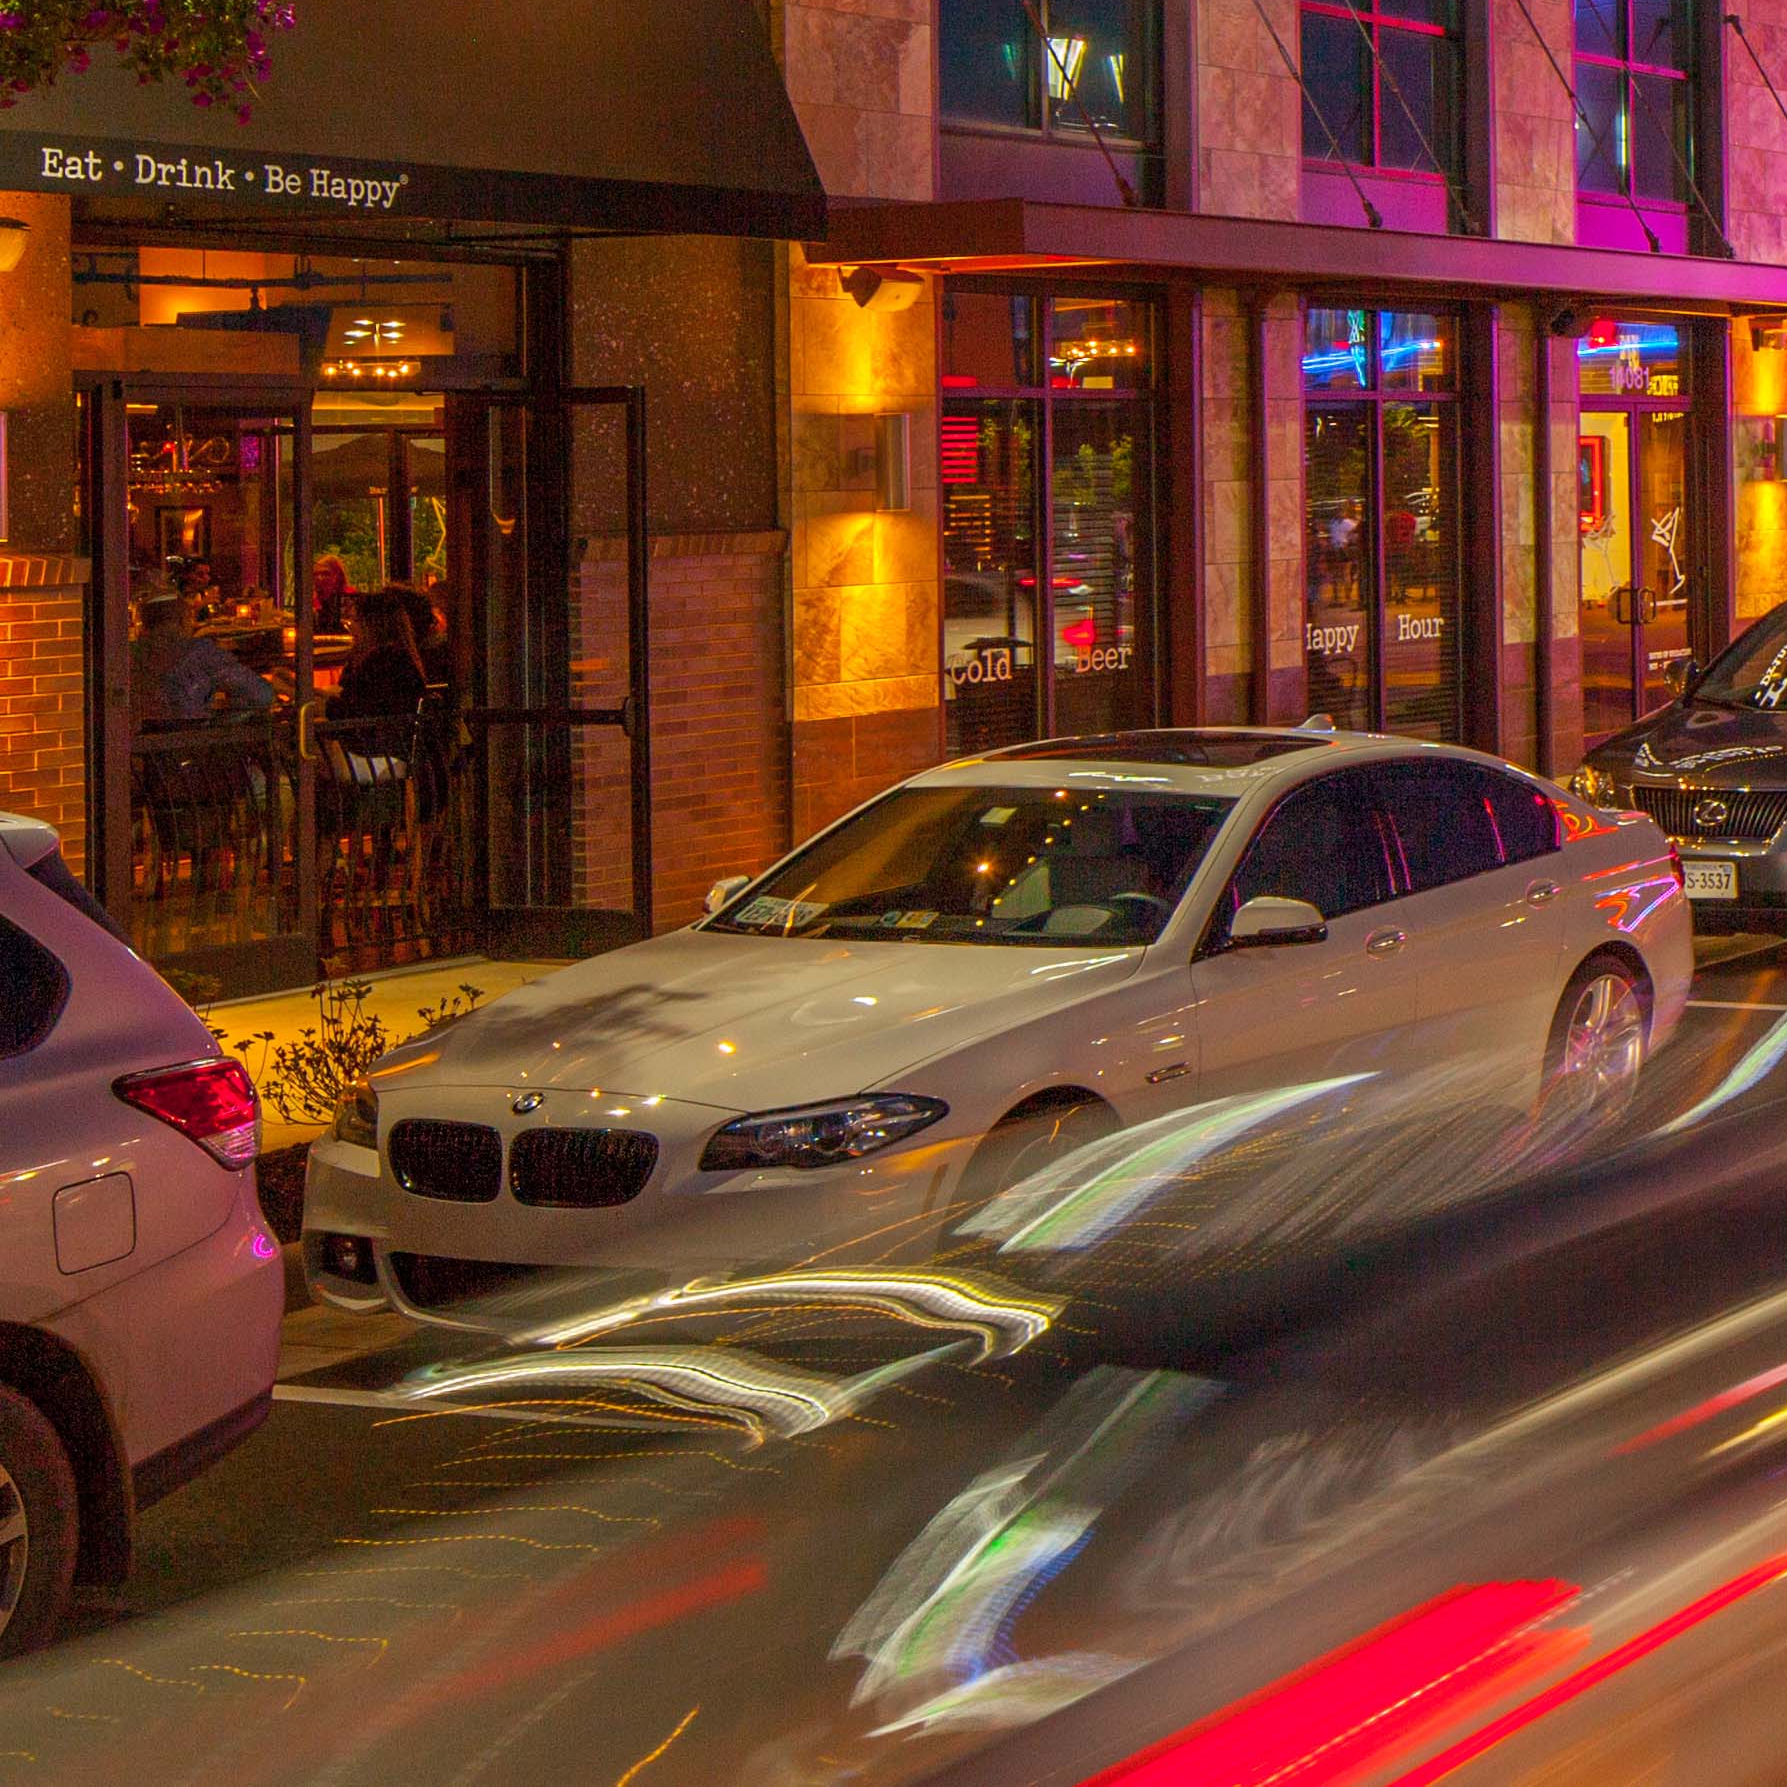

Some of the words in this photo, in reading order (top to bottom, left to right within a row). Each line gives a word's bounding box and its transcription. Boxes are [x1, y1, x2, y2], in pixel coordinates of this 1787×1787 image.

[42, 147, 102, 182] Eat
[135, 154, 235, 191] Drink
[264, 165, 301, 194] Be
[1397, 613, 1446, 642] Hour
[949, 646, 1013, 686] Cold
[1075, 643, 1133, 675] Beer
[1687, 872, 1731, 890] S-3537
